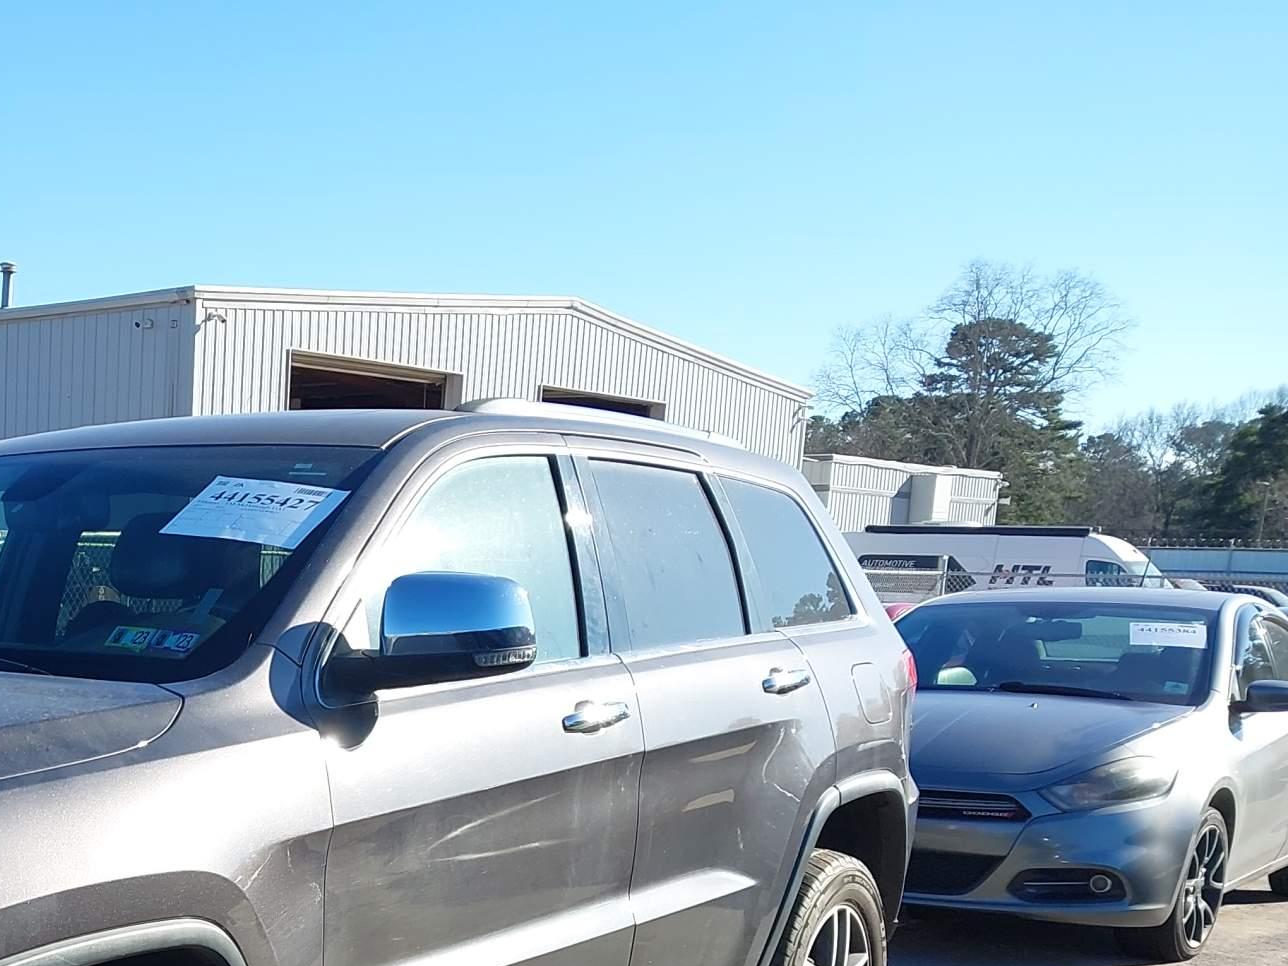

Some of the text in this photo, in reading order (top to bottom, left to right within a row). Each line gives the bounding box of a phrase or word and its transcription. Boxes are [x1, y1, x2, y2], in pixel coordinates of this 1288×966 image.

[210, 490, 320, 511] 44155427
[861, 559, 916, 568] AUTOMOTIVE
[133, 631, 150, 644] 23
[176, 634, 194, 648] 23
